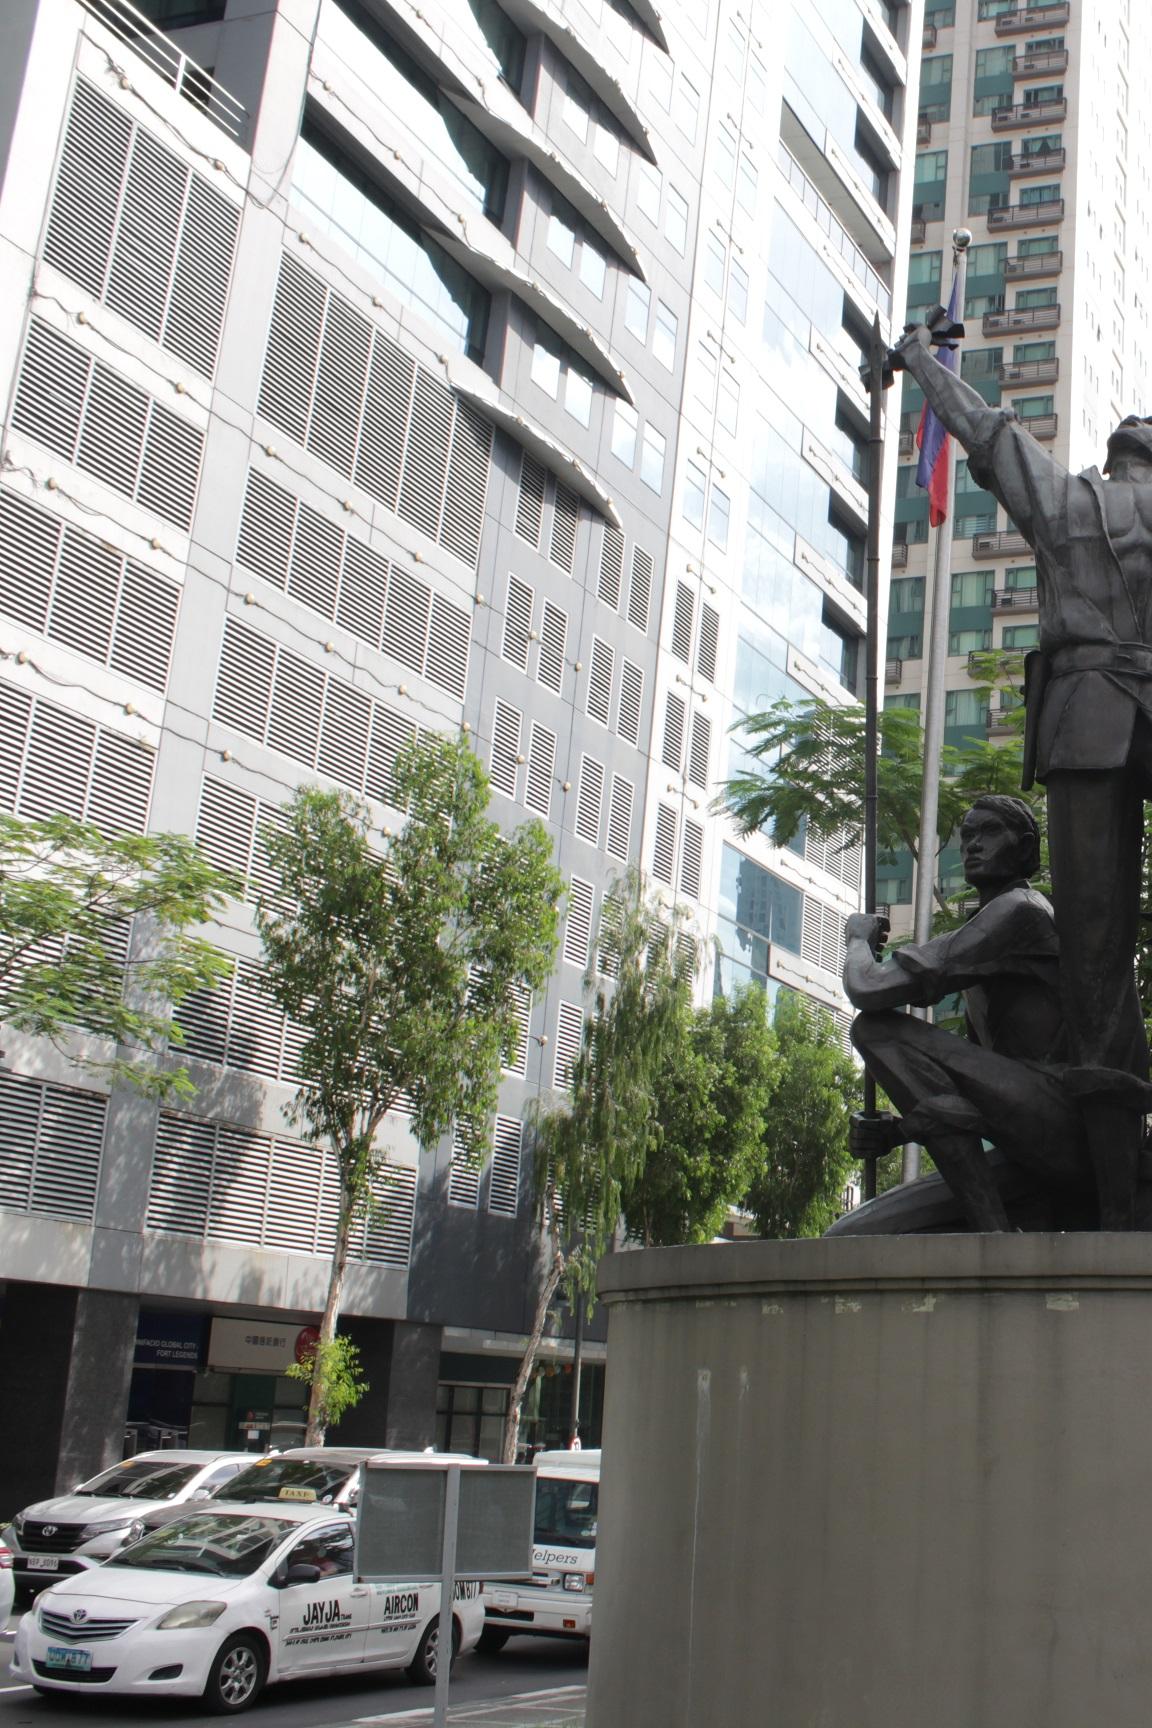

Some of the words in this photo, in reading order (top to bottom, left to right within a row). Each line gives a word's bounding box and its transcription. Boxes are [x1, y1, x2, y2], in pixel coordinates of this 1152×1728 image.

[161, 1340, 183, 1349] GLOBAL
[303, 1600, 341, 1625] JAYJA
[384, 1592, 419, 1616] AIRCON
